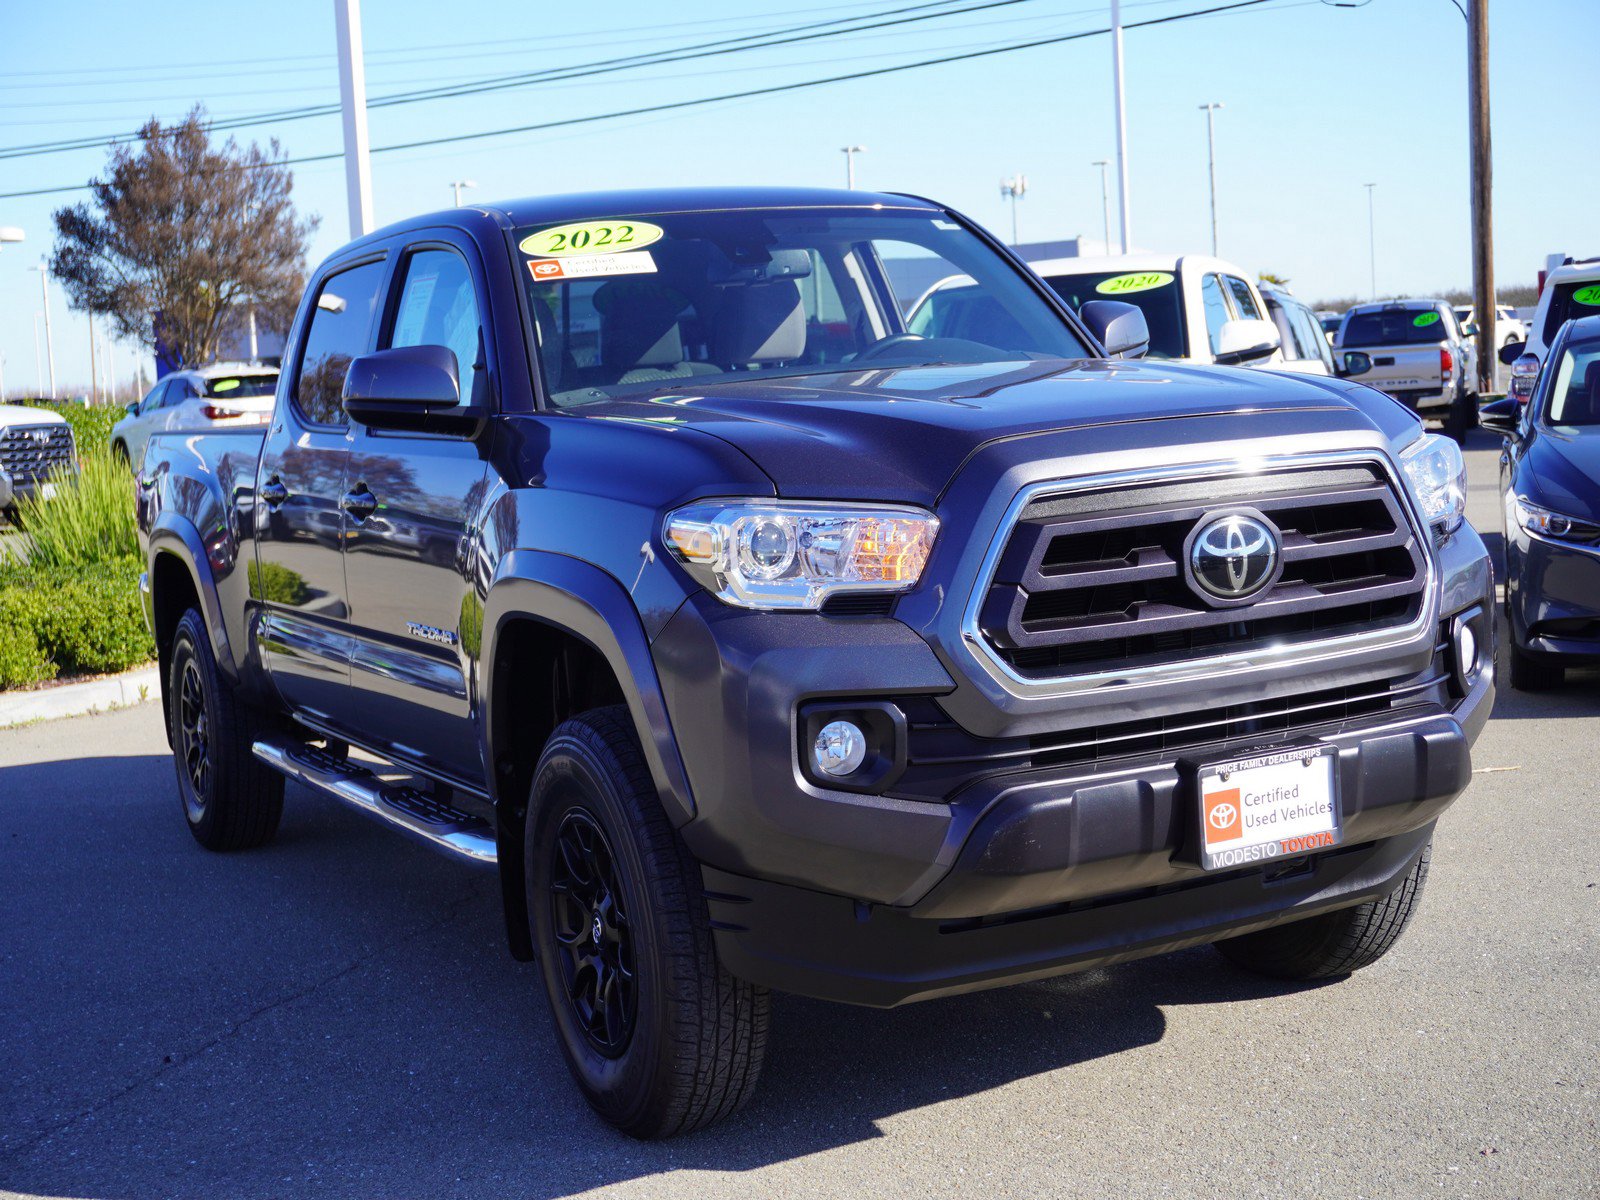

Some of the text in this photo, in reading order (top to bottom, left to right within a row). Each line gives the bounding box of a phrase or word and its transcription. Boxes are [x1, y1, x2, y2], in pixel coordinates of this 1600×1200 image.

[548, 225, 634, 252] 2022
[1109, 274, 1160, 291] 2020
[1366, 379, 1418, 388] ACOMA
[405, 621, 458, 645] TACOMA
[1215, 749, 1321, 775] PRICE FAMILY DEALERSHIPS
[1244, 784, 1300, 807] Certified
[1245, 802, 1333, 828] Used Vehicles
[1212, 832, 1335, 869] MODESTO TOYOTA
